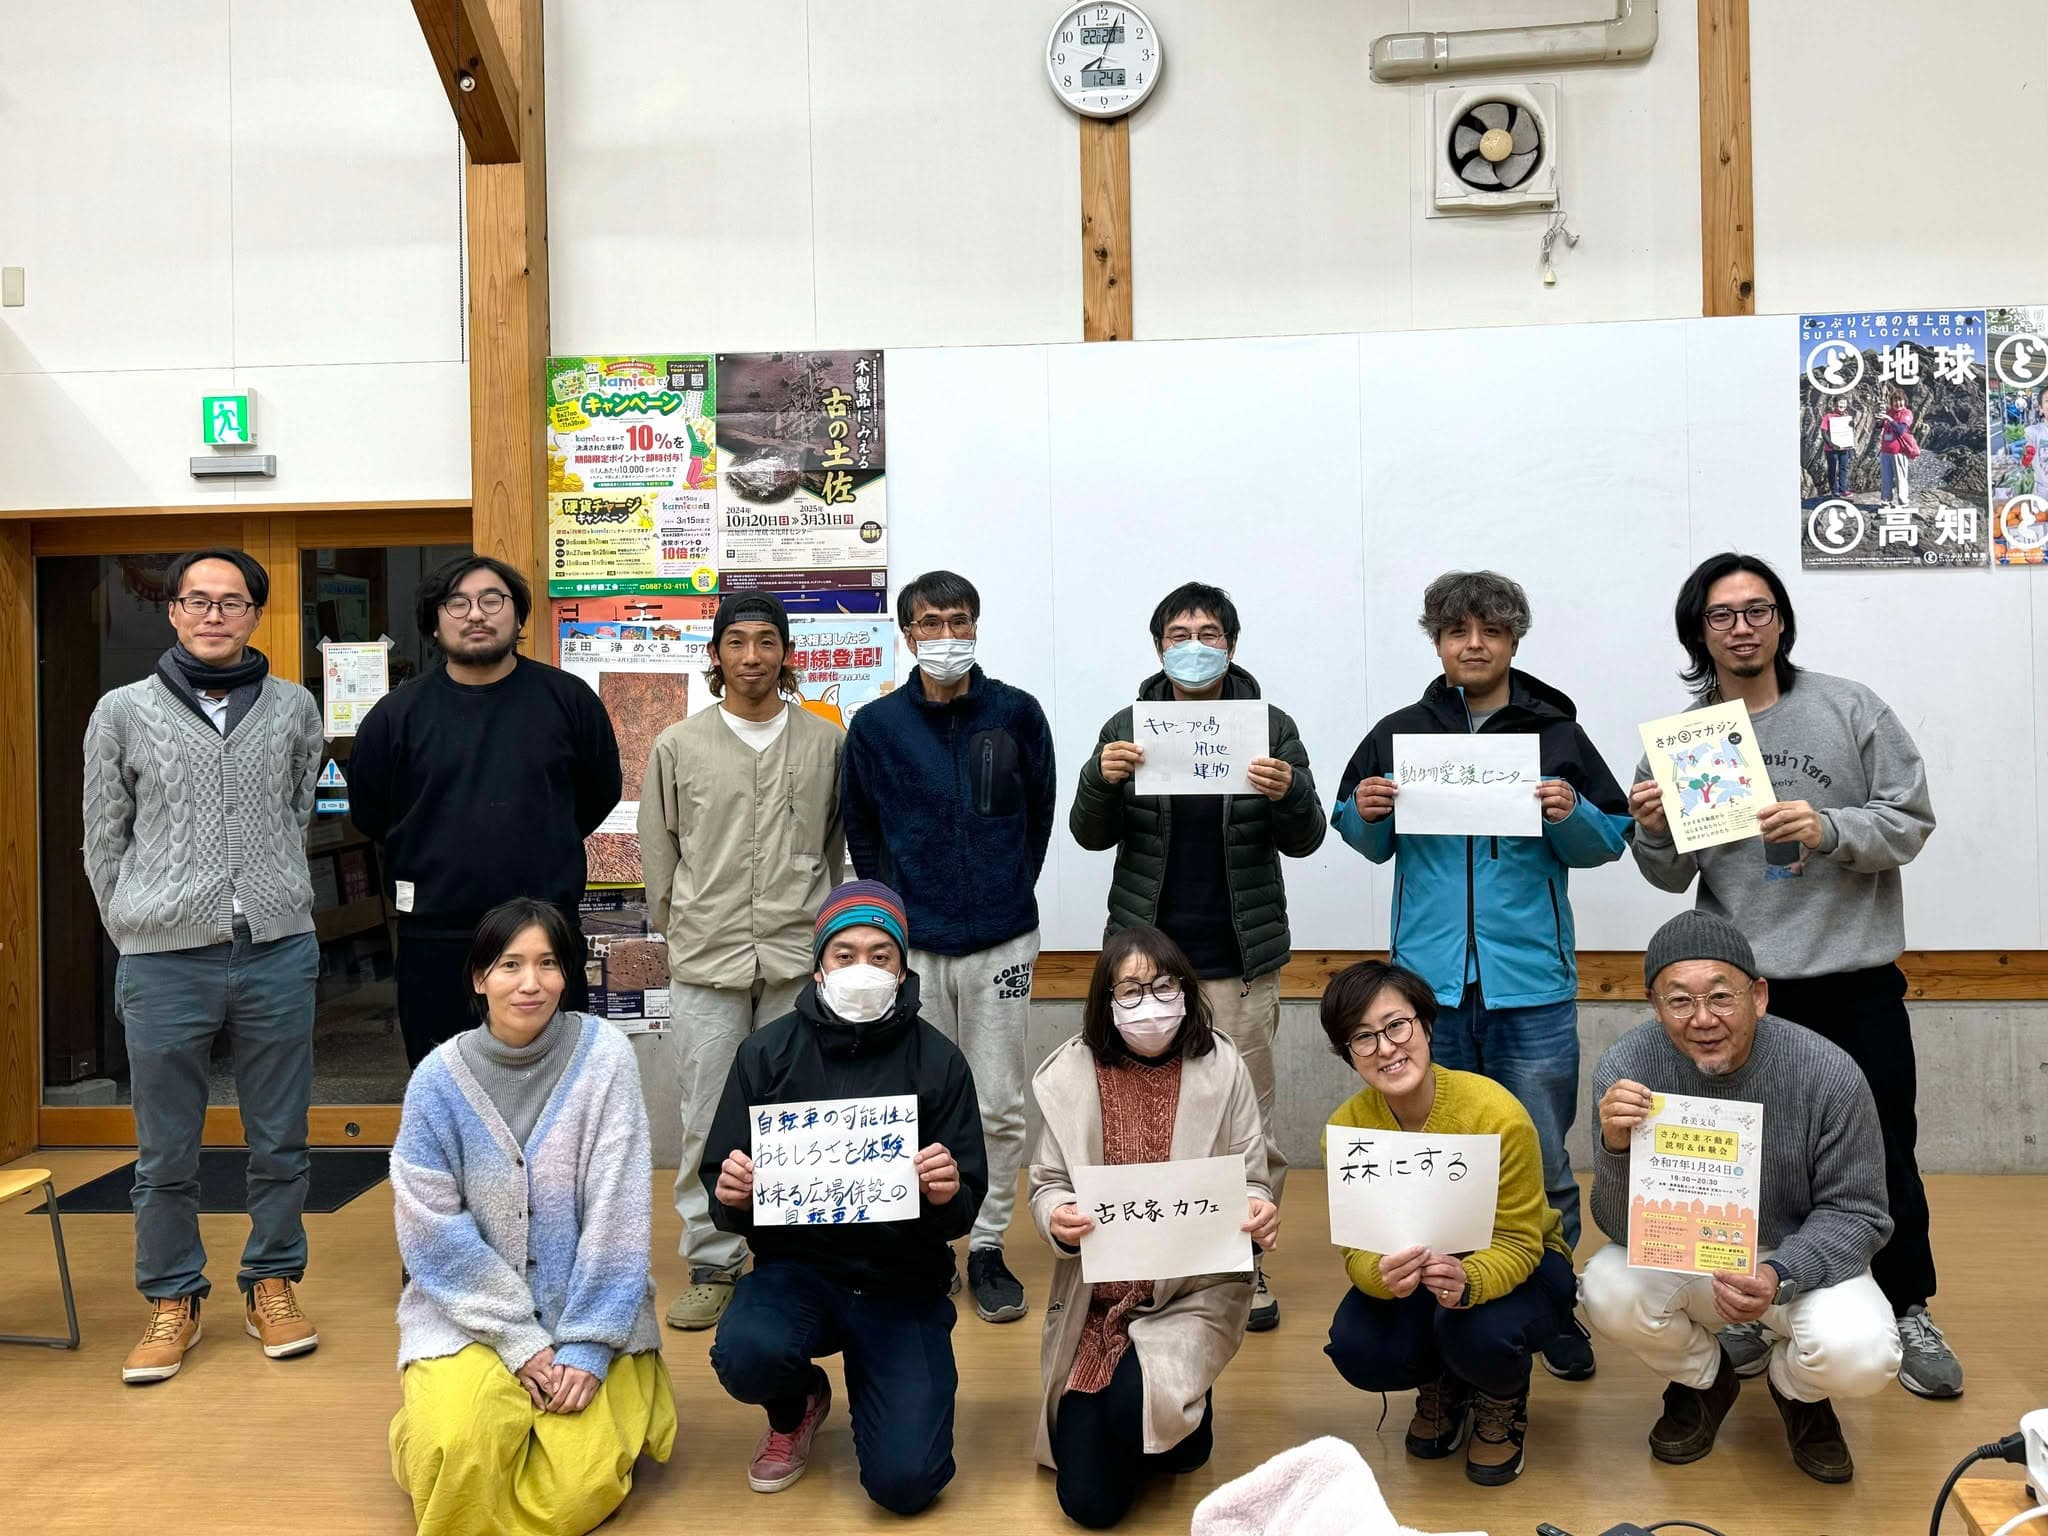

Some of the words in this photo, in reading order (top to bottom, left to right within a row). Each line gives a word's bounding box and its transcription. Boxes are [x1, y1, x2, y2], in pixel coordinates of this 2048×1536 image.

[1077, 15, 1087, 26] 11
[1096, 8, 1109, 21] 12
[1062, 31, 1074, 43] 10
[1136, 27, 1144, 40] 2
[1057, 53, 1065, 65] 9
[1142, 48, 1150, 61] 3
[1064, 75, 1072, 87] 8
[1136, 72, 1144, 84] 4
[1803, 331, 1859, 341] SUPER
[1870, 328, 1921, 338] LOCAL
[1932, 325, 1982, 336] KOCHI
[1878, 344, 1977, 386] 地球
[585, 393, 681, 414] キャンペーン
[855, 358, 871, 469] 木製品にみえる
[822, 388, 856, 505] 古の土佐
[563, 497, 642, 515] 硬貨チャージ
[799, 505, 825, 513] 2025年
[576, 513, 629, 525] キャンペーン
[726, 515, 777, 527] 10月20日
[800, 513, 842, 526] 3月31日
[1878, 505, 1977, 547] 高知
[662, 547, 688, 559] 10倍
[633, 642, 670, 653] めぐる
[1399, 760, 1537, 786] 動物愛護センター
[758, 1105, 917, 1136] 自転車の可能性と
[1660, 1131, 1735, 1146] さかさま不動産
[754, 1133, 910, 1168] おもしろさを体験
[1340, 1137, 1468, 1185] 森にする
[1649, 1156, 1731, 1176] 令和7年1月24日
[755, 1177, 908, 1207] 出来る広場併設の
[785, 1204, 870, 1225] 自転車屋
[1094, 1199, 1165, 1225] 古民家
[1173, 1199, 1220, 1216] カフェ
